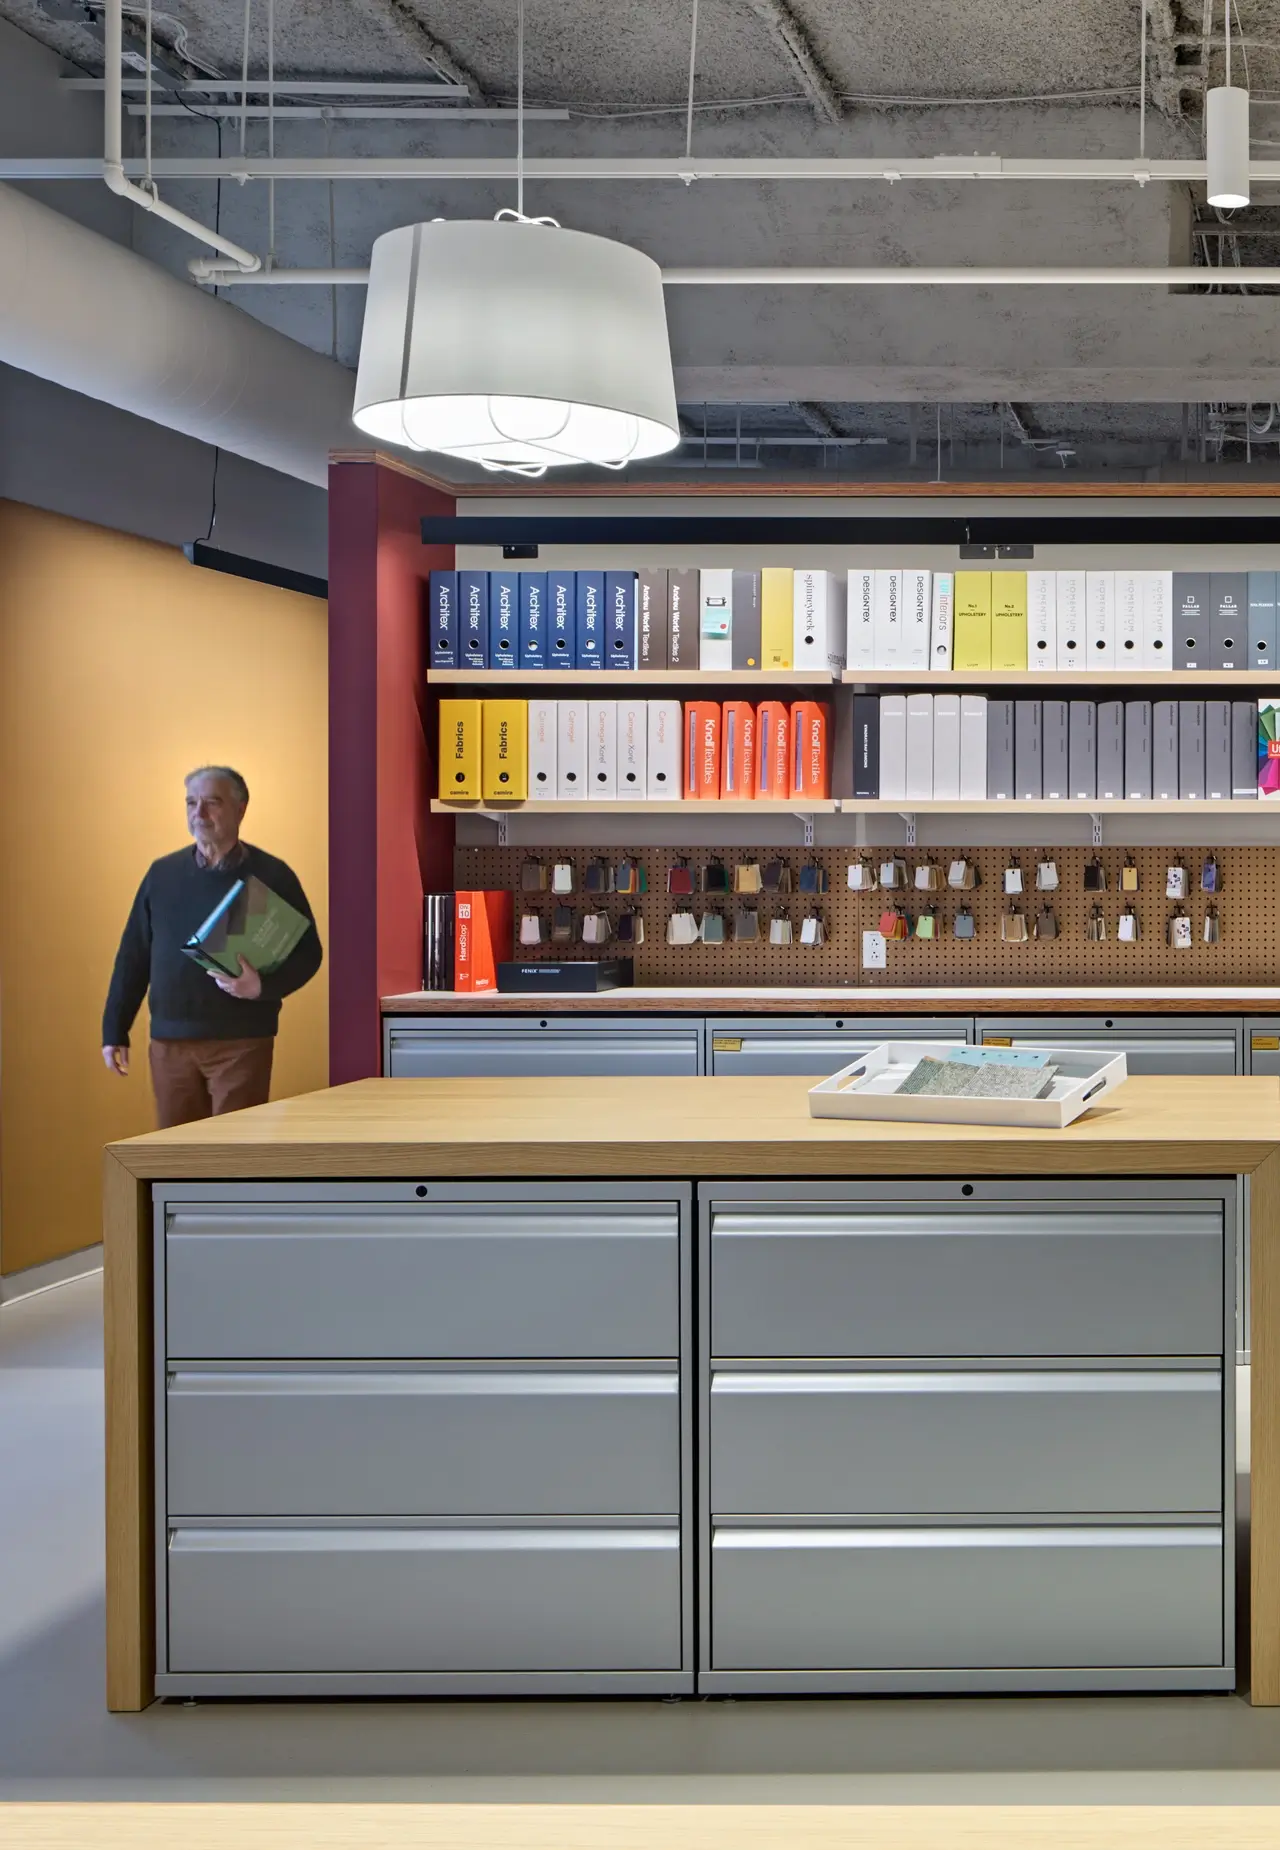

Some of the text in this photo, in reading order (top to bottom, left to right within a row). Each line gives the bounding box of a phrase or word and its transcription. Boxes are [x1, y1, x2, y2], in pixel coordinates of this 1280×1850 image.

[439, 585, 450, 630] Architex
[470, 585, 480, 630] Architex
[500, 585, 511, 630] Architex
[530, 586, 540, 631] Architex
[556, 585, 567, 630] Architex
[586, 586, 597, 631] Architex
[615, 586, 626, 631] Architex
[672, 585, 680, 611] Andreu
[804, 574, 815, 632] spinneybeck
[672, 612, 680, 632] World
[456, 721, 464, 759] Fabrics
[499, 721, 508, 759] Fabrics
[459, 924, 468, 961] HardStop
